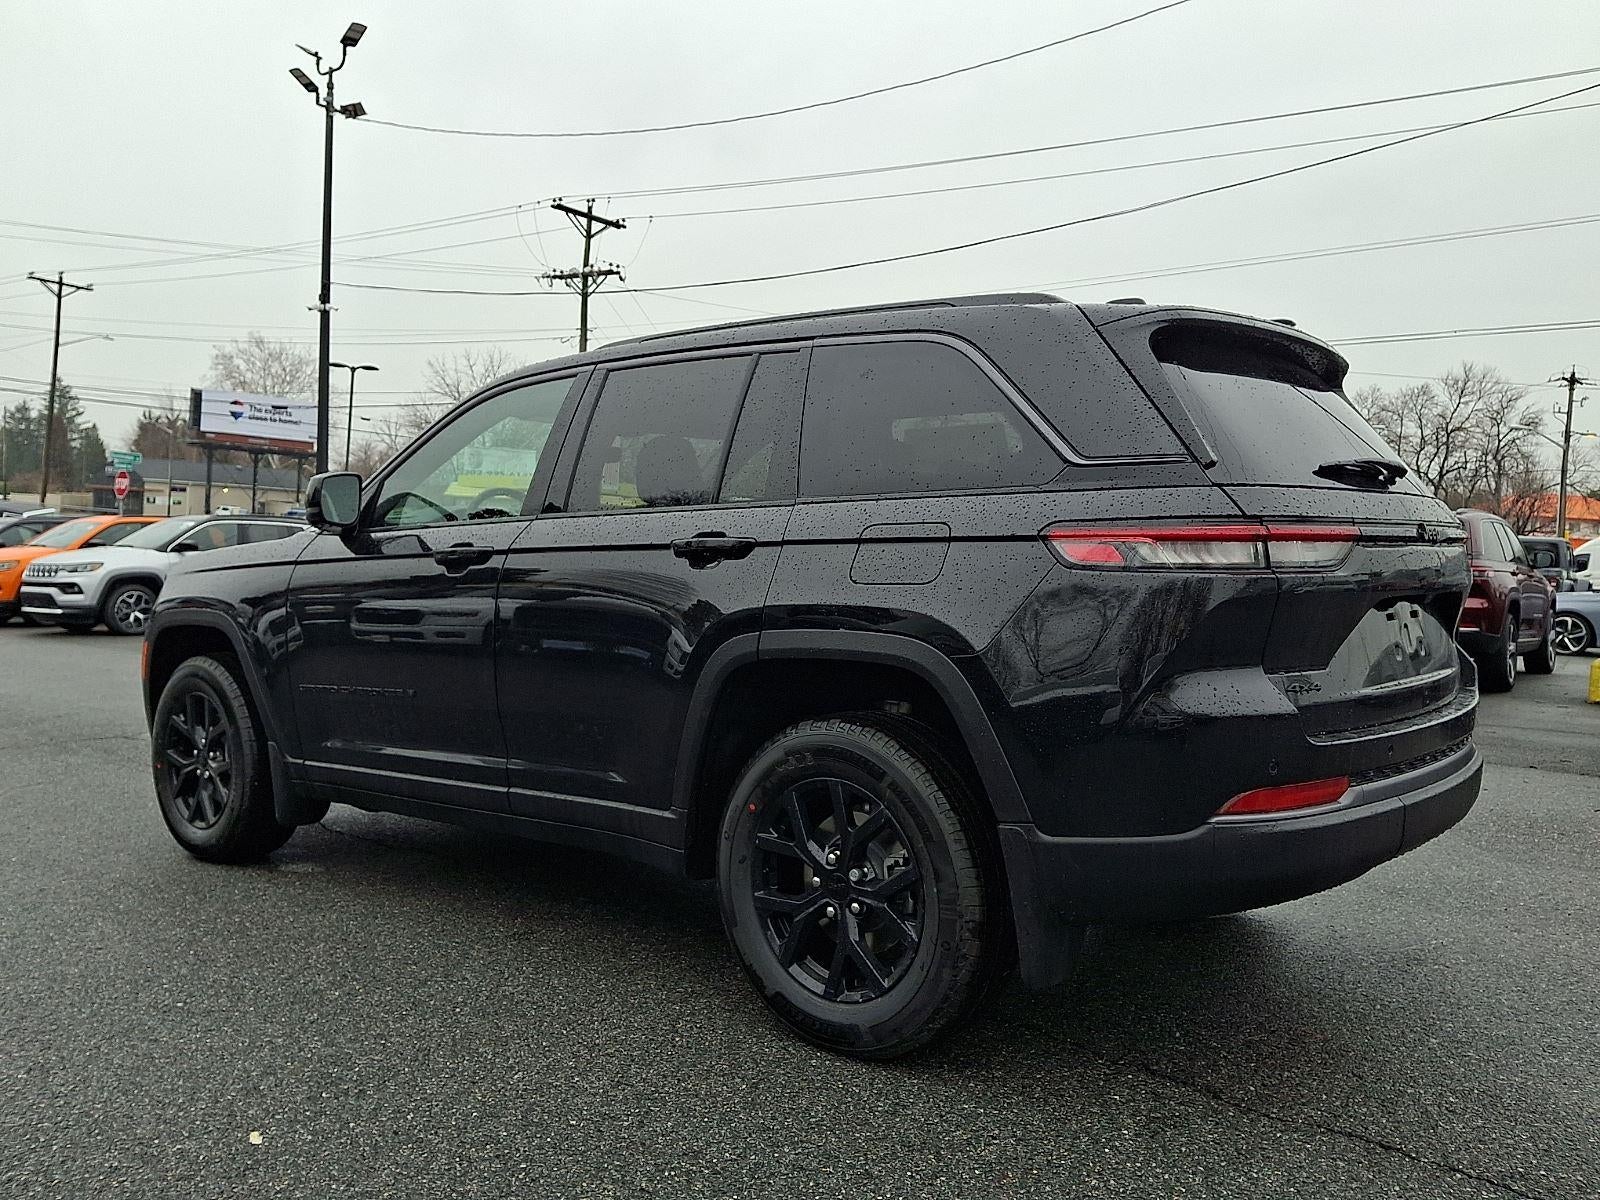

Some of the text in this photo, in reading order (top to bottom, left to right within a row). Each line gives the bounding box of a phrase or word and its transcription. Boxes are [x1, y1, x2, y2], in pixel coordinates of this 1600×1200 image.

[249, 404, 292, 416] The experts
[248, 413, 268, 421] close
[116, 477, 129, 488] STOP
[1423, 523, 1441, 543] Jeep
